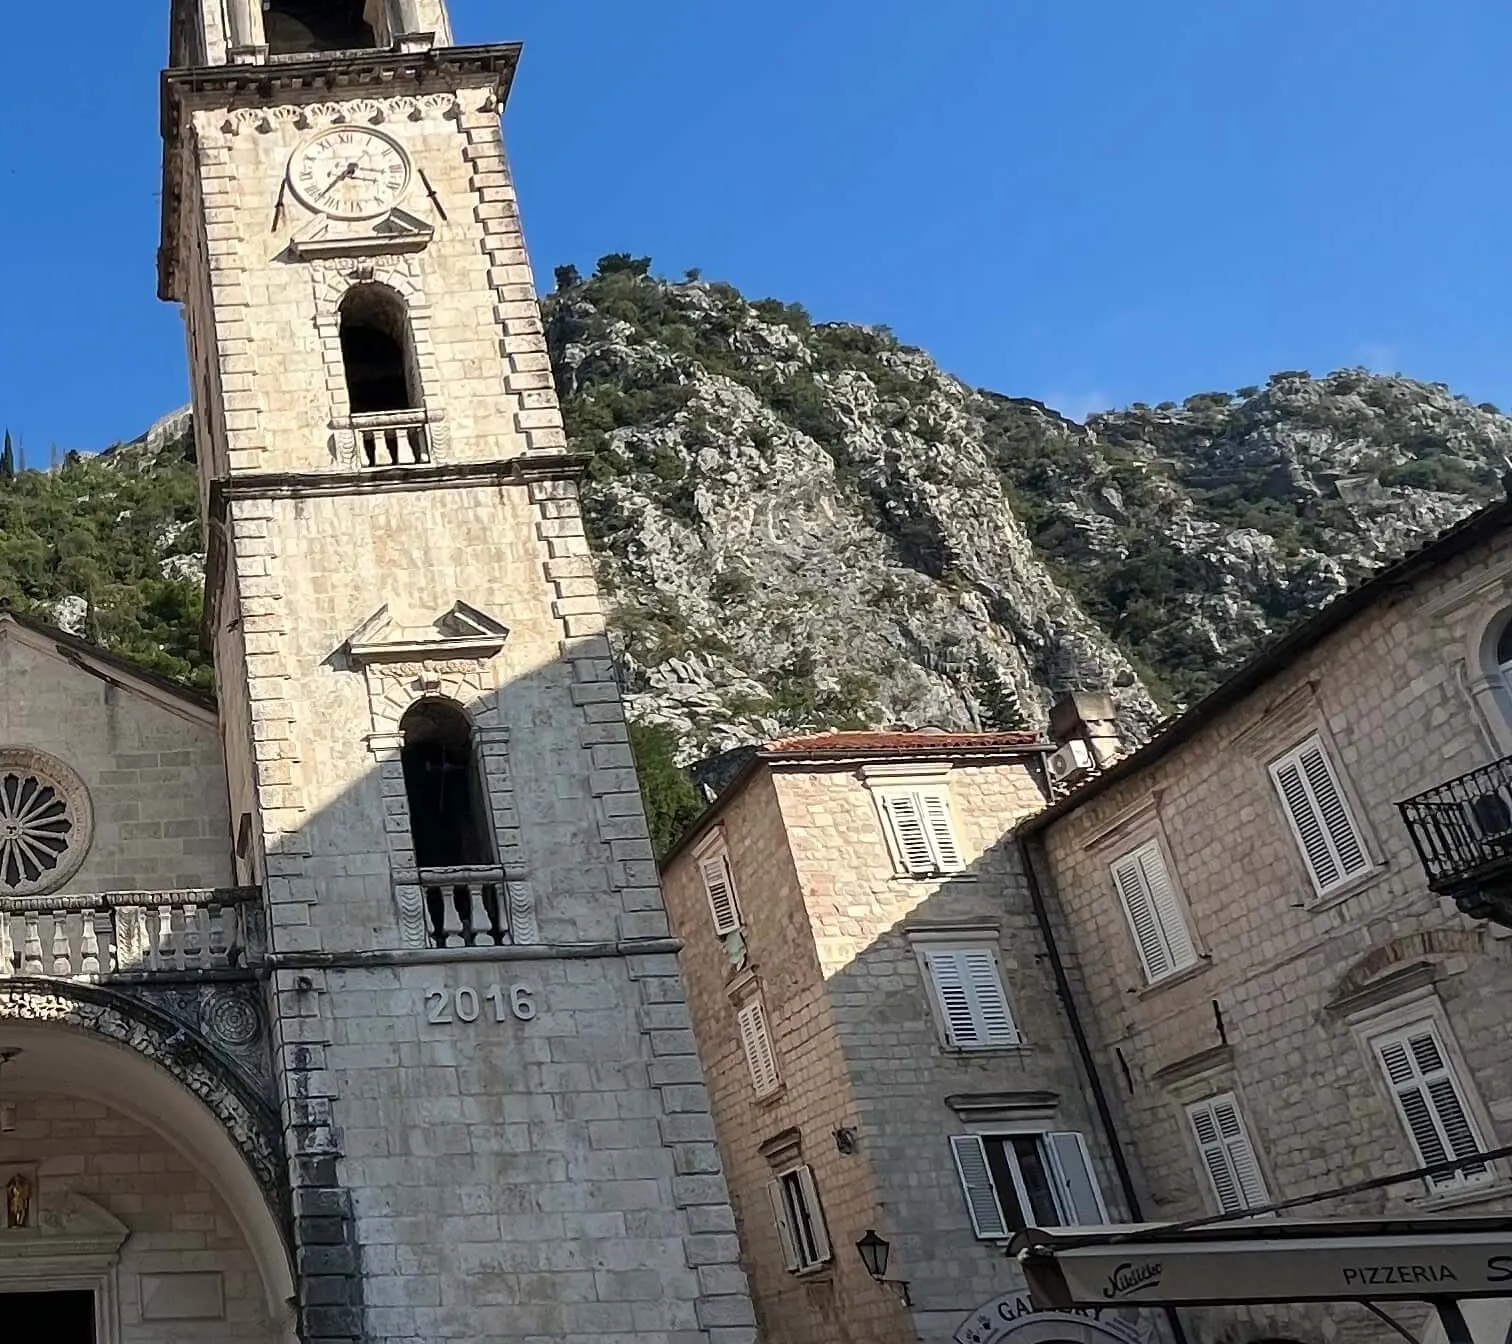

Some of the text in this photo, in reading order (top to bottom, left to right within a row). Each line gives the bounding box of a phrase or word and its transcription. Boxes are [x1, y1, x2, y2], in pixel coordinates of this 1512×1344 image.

[338, 133, 354, 145] XII
[424, 983, 538, 1025] 2016
[1343, 1264, 1458, 1286] PIZZERIA
[998, 1294, 1102, 1322] GALY
